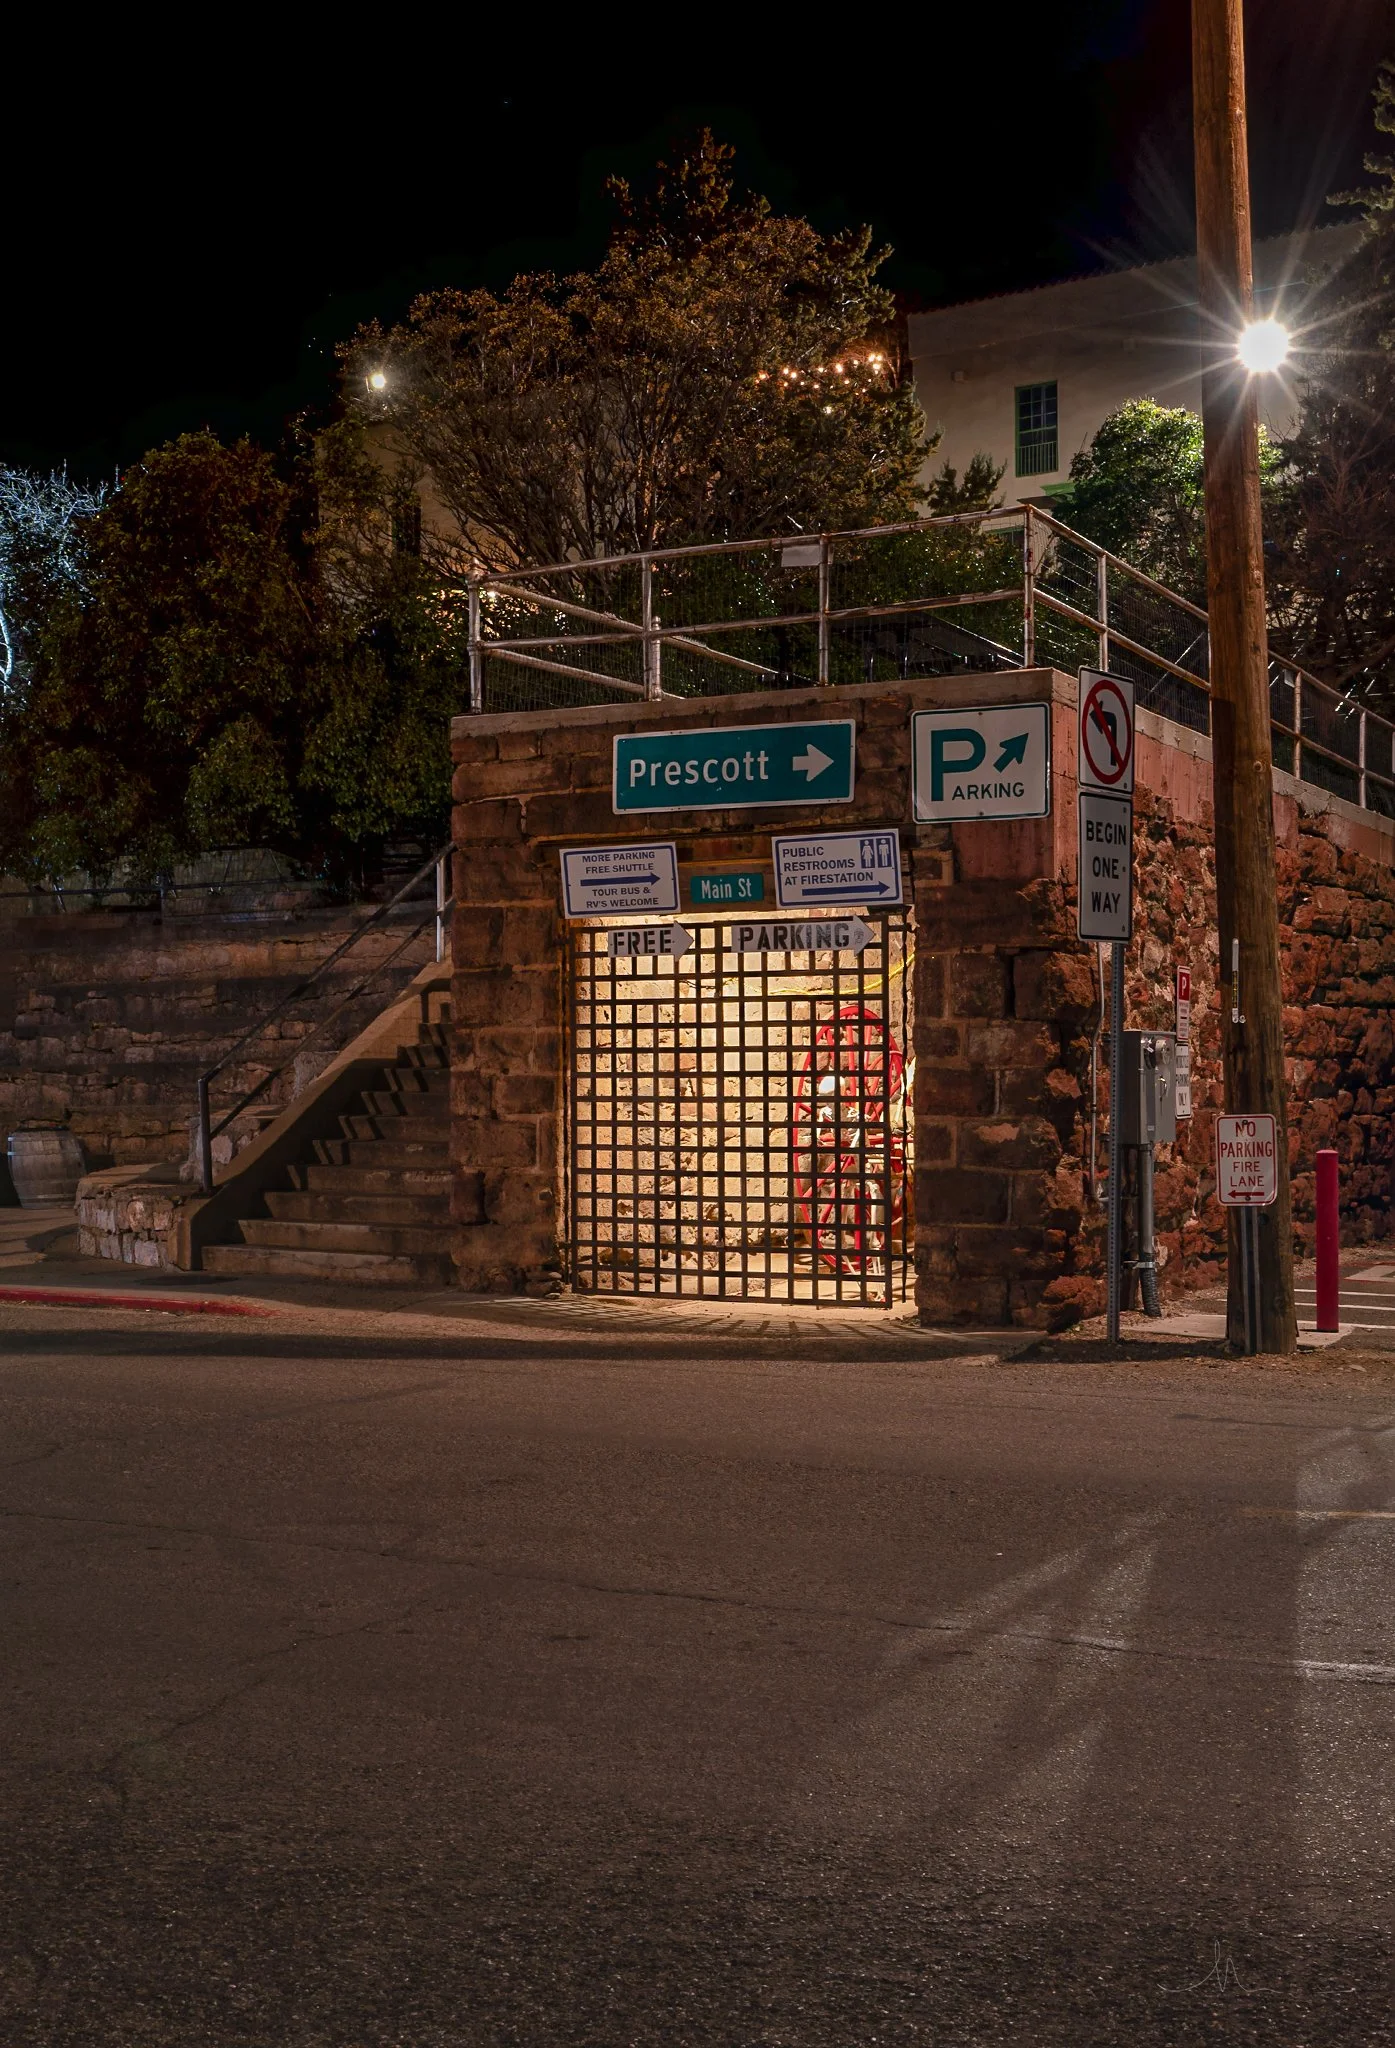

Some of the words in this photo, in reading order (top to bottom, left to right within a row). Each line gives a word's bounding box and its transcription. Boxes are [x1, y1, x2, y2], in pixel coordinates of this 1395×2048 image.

[629, 750, 769, 788] Prescott
[1086, 820, 1127, 846] BEGIN
[582, 853, 611, 863] MORE
[613, 851, 656, 861] PARKING
[782, 846, 824, 858] PUBLIC
[585, 865, 611, 874] FREE
[612, 863, 654, 873] SHUTTLE
[783, 858, 855, 872] RESTROOMS
[1092, 856, 1119, 880] ONE
[784, 875, 799, 886] AT
[801, 872, 874, 885] FIRESTATION
[592, 888, 618, 897] TOUR
[620, 887, 640, 895] BUS
[701, 878, 732, 899] Main
[738, 877, 752, 898] St
[586, 899, 608, 909] RV'S
[610, 897, 659, 907] WELCOME
[1091, 891, 1121, 915] WAY
[613, 929, 672, 955] FREE
[738, 922, 850, 951] PARKING
[1235, 1121, 1256, 1137] NO
[1220, 1141, 1273, 1158] PARKING
[1233, 1161, 1261, 1173] FIRE
[1230, 1176, 1265, 1187] LANE
